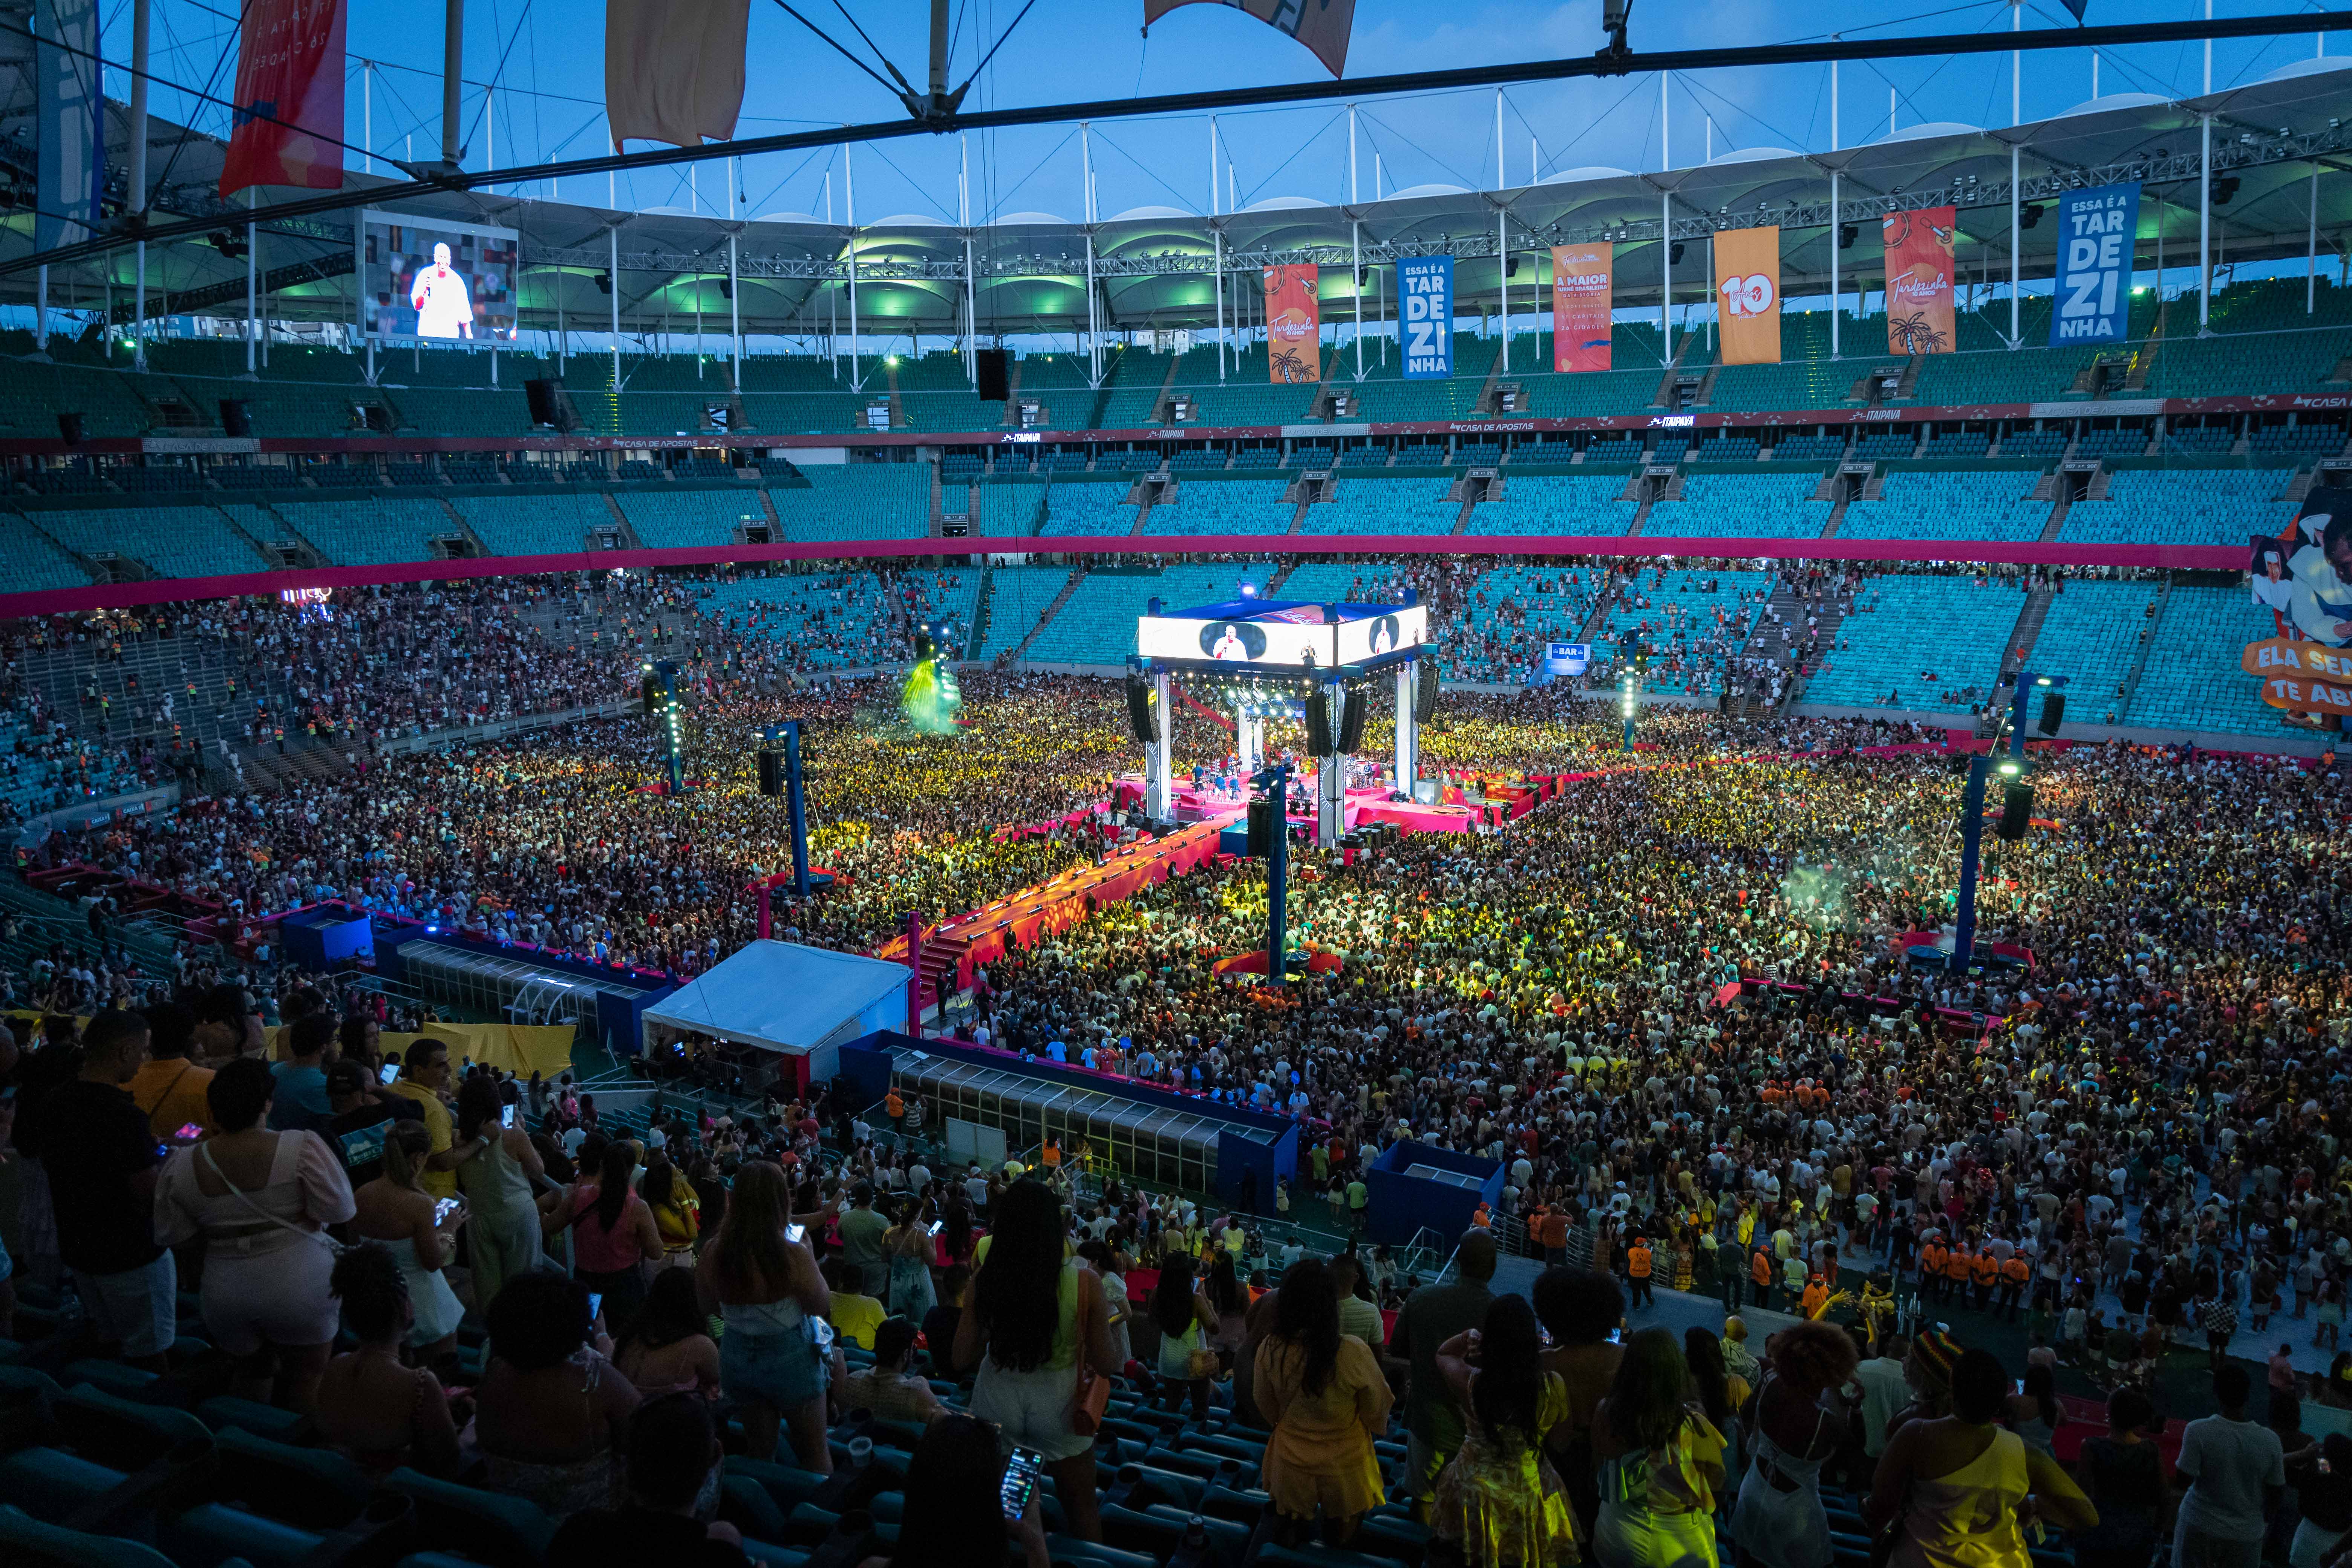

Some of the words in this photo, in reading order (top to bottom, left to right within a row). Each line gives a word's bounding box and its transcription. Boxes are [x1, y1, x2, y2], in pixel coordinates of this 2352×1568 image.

[2072, 200, 2103, 213] ESSA
[2107, 195, 2114, 207] É
[2117, 196, 2126, 207] A
[2072, 210, 2124, 236] TAR
[2067, 234, 2123, 272] DE
[1406, 266, 1428, 275] ESSA
[1431, 263, 1436, 274] É
[1438, 265, 1445, 273] A
[1406, 276, 1444, 294] TAR
[1557, 277, 1565, 286] A
[1567, 274, 1608, 286] MAIOR
[1890, 271, 1948, 303] Tardezinha
[1721, 274, 1773, 315] 10
[2061, 270, 2118, 318] ZI
[1407, 294, 1444, 321] DE
[1270, 314, 1314, 340] Tardezinha
[2060, 318, 2113, 338] NHA
[1408, 322, 1445, 357] ZI
[1409, 358, 1447, 372] NHA
[2311, 398, 2347, 407] CASA
[1662, 416, 1694, 427] ITAIPAVA
[1866, 410, 1901, 420] ITAIPAVA
[1014, 433, 1040, 443] ITAIPAVA
[1159, 429, 1185, 438] ITAIPAVA
[2259, 646, 2301, 669] ELA
[2270, 679, 2301, 701] TE
